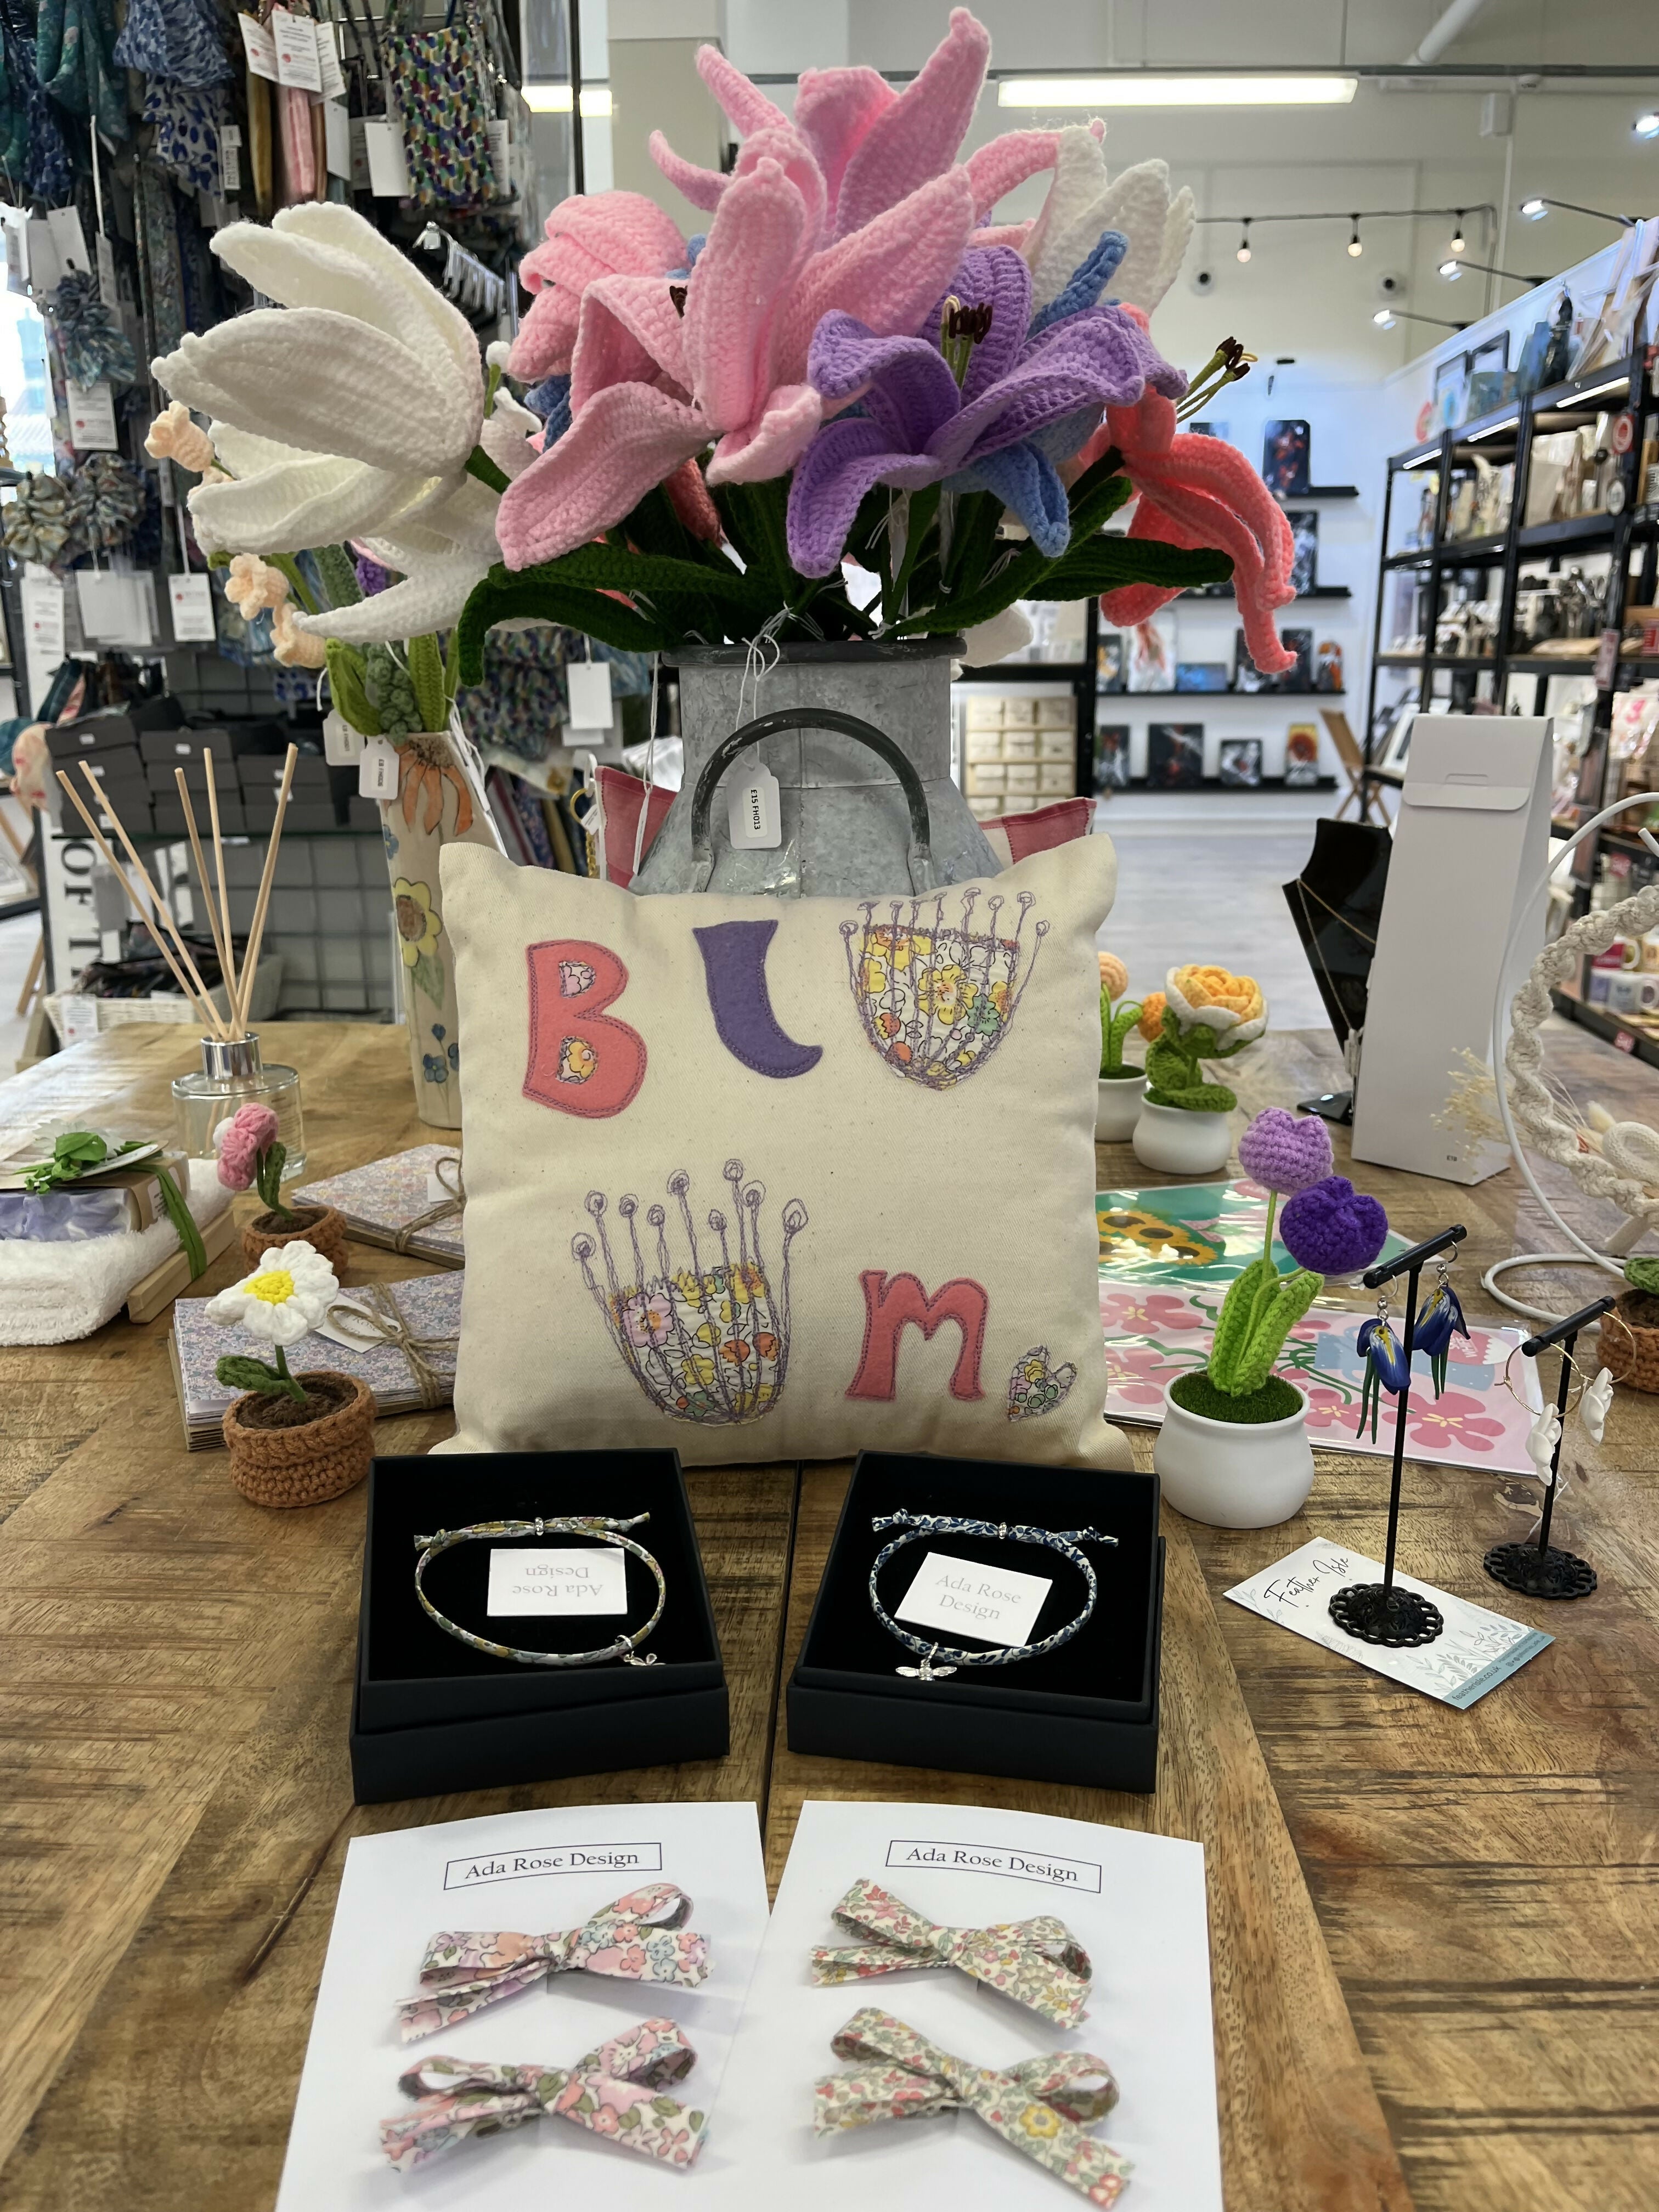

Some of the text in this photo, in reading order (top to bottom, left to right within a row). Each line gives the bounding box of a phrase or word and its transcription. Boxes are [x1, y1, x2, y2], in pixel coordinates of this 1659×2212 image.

[752, 805, 761, 830] FH013
[524, 1564, 589, 1578] Design
[512, 1584, 604, 1597] Ada Rose
[935, 1575, 1022, 1604] Ada Rose
[939, 1594, 1000, 1620] Design
[465, 1852, 640, 1879] Ada Rose Design
[906, 1847, 1079, 1883] Ada Rose Design
